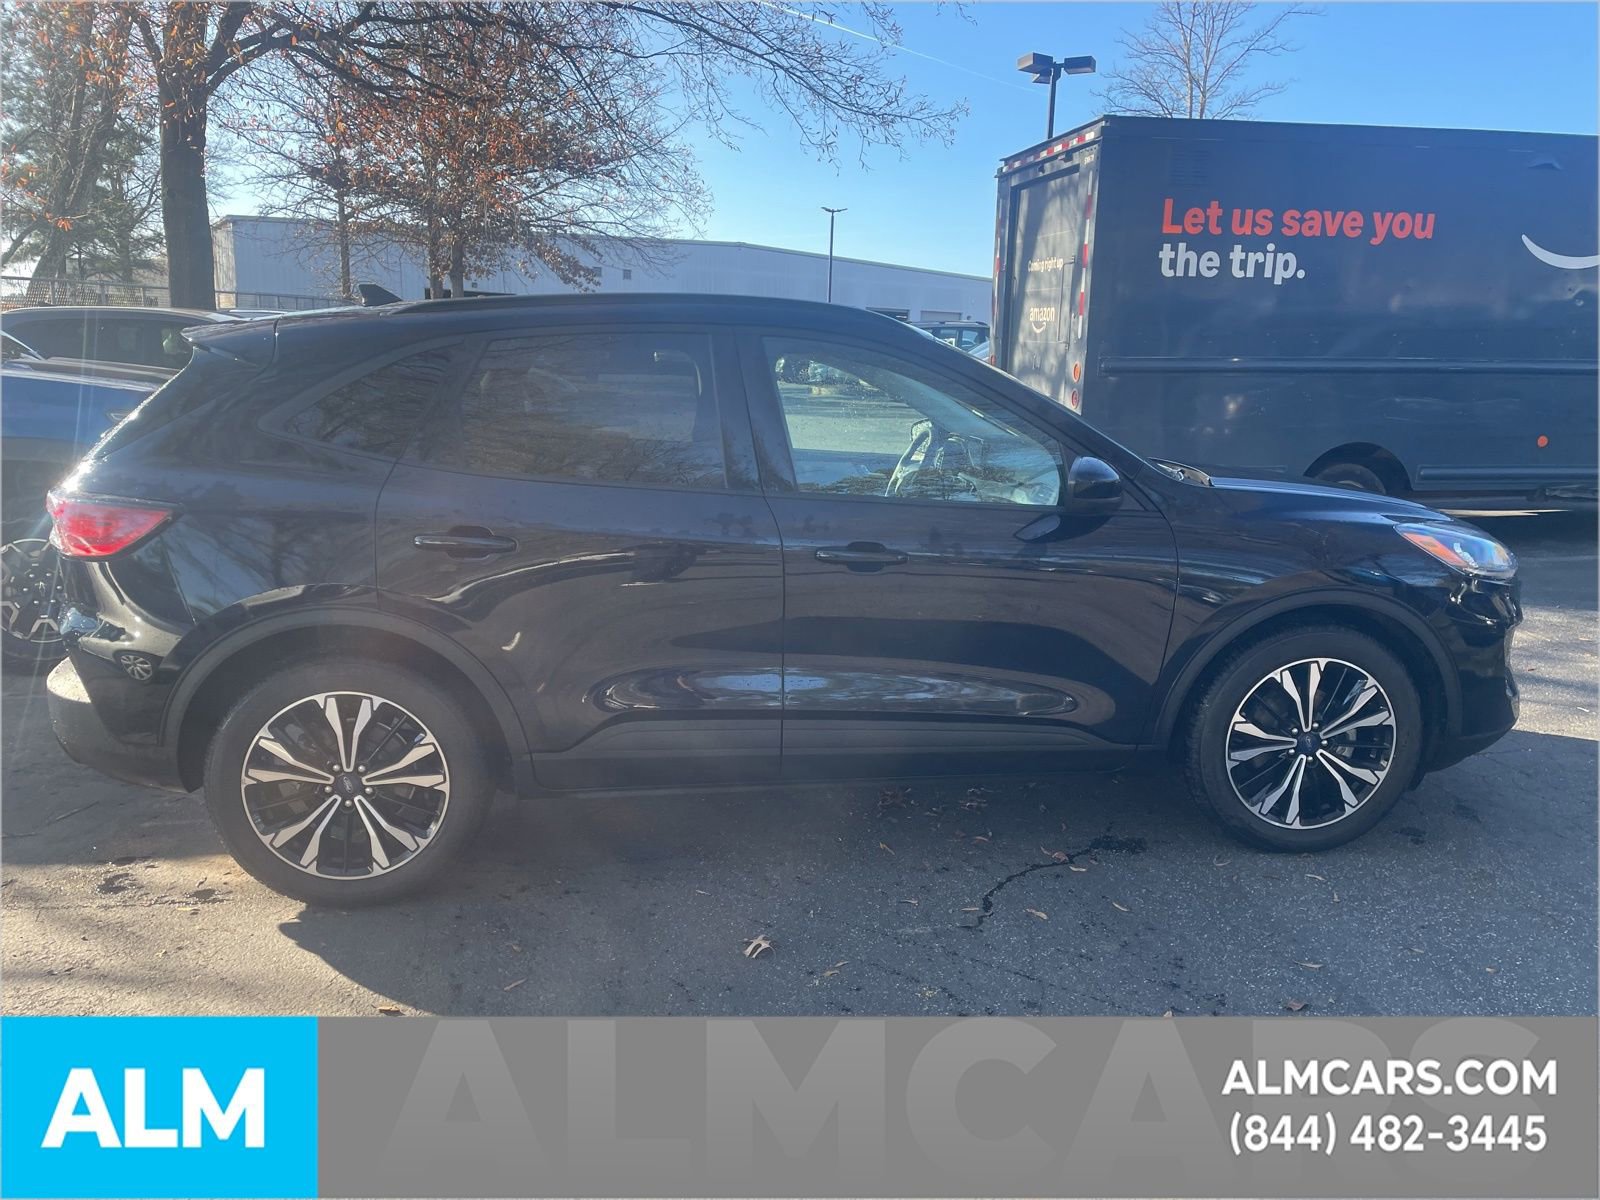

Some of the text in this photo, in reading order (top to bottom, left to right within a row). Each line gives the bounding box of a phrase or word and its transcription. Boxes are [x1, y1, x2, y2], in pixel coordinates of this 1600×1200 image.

[1161, 198, 1434, 246] Let us save you
[1159, 242, 1307, 286] the trip.
[1029, 307, 1055, 322] amazon
